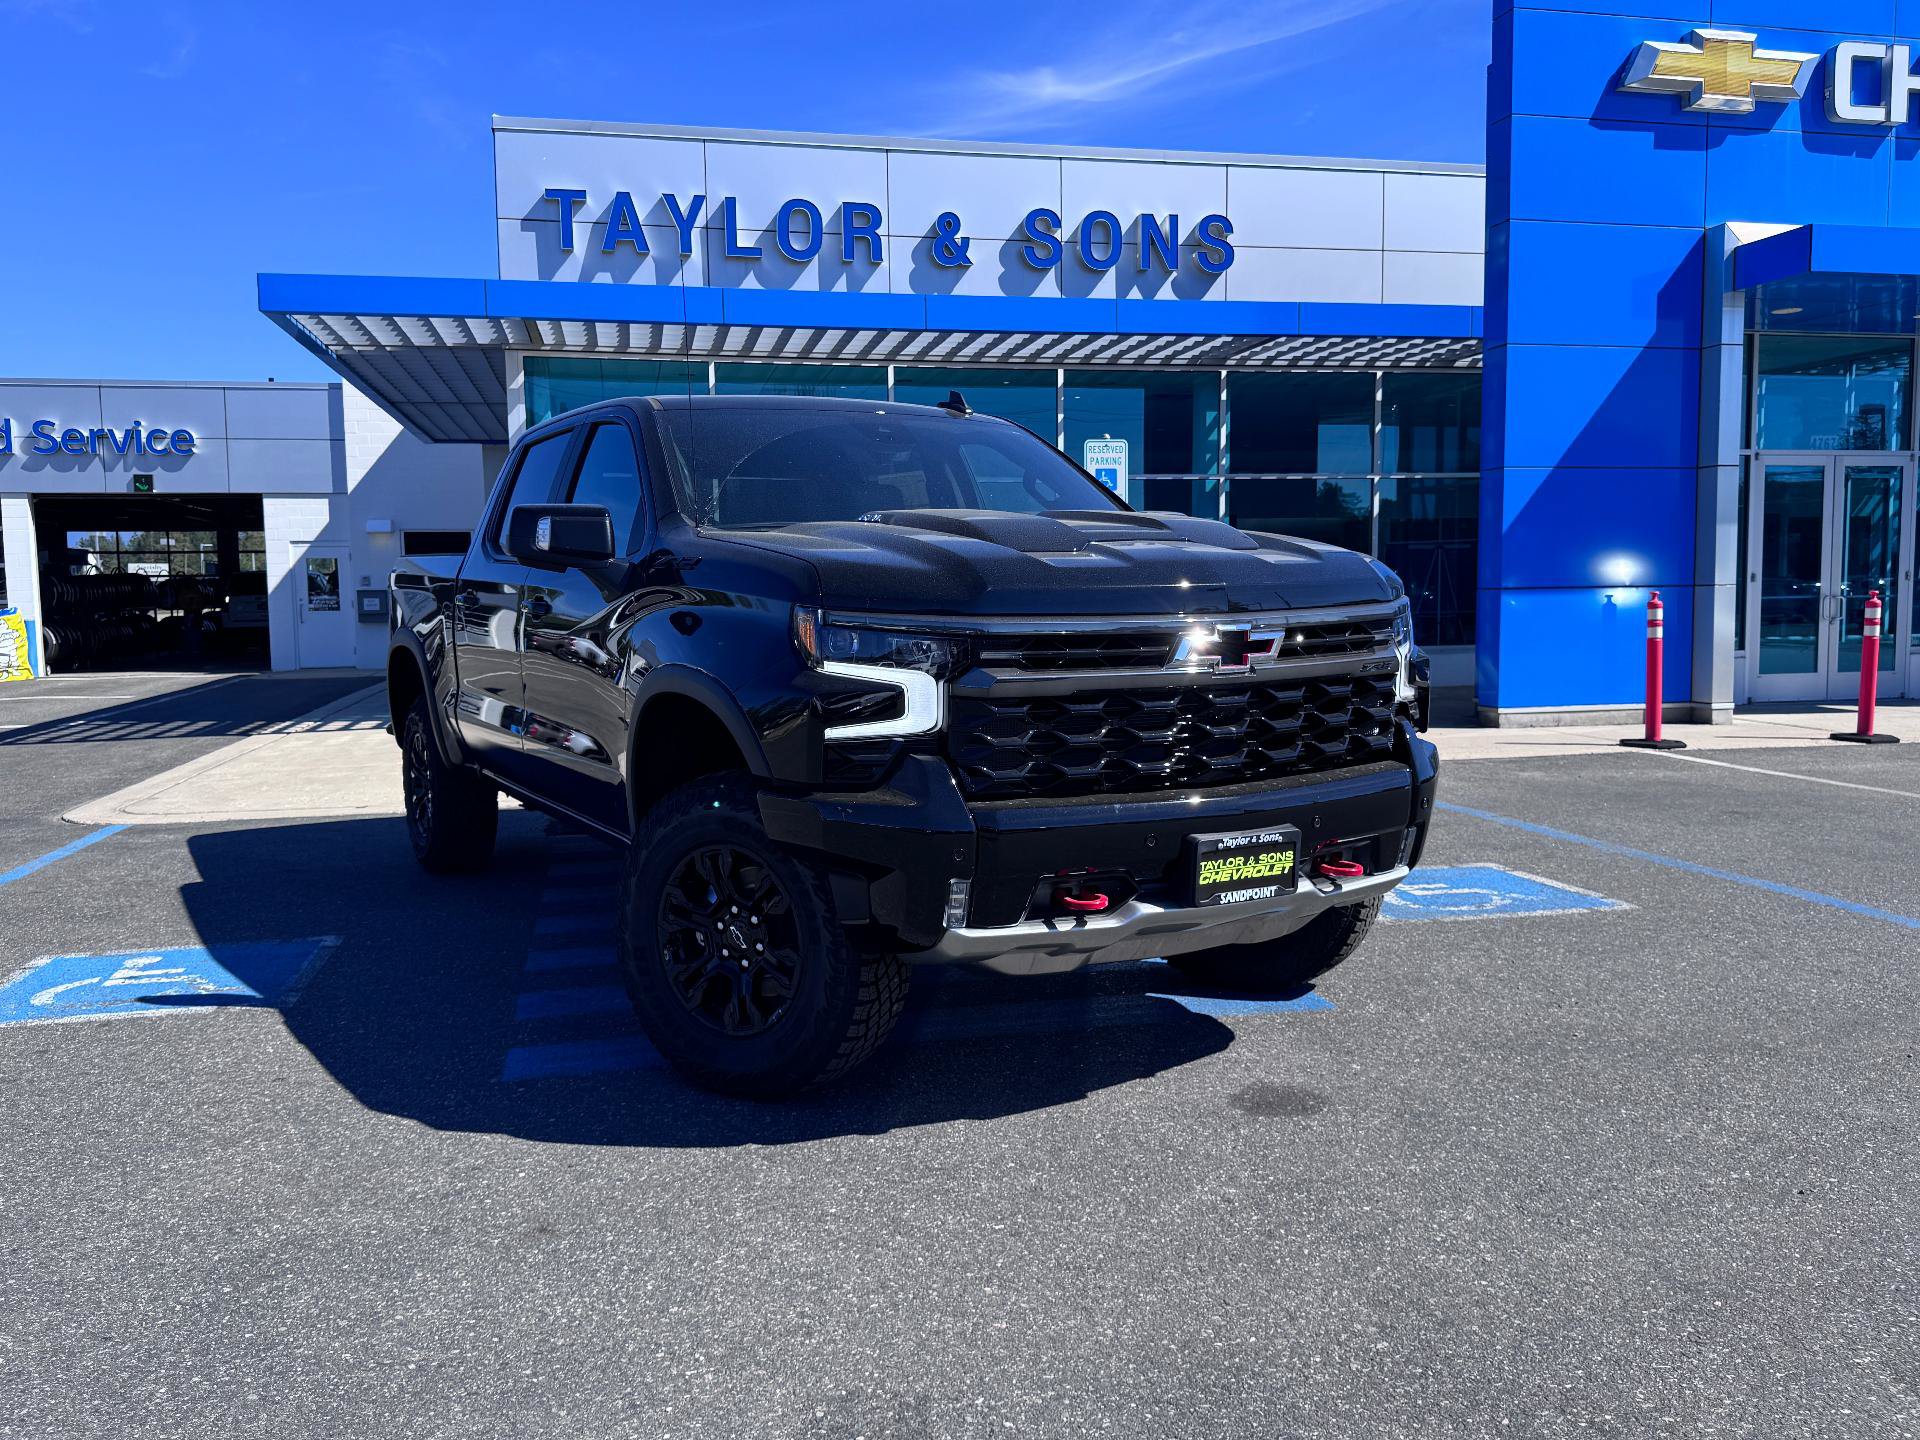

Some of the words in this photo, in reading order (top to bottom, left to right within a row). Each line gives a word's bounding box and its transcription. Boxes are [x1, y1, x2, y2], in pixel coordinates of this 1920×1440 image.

[544, 188, 884, 263] TAYLOR
[931, 211, 974, 267] &
[1021, 208, 1235, 274] SONS
[32, 419, 195, 456] Service
[1088, 445, 1124, 454] RESERVED
[1089, 457, 1122, 466] PARKING
[1222, 837, 1251, 849] Taylor
[1258, 833, 1280, 843] Sons
[1200, 857, 1245, 872] TAYLOR
[1247, 856, 1256, 867] &
[1258, 851, 1294, 864] SONS
[1199, 862, 1294, 885] CHEVROLET
[1220, 886, 1277, 905] SANDPOINT
